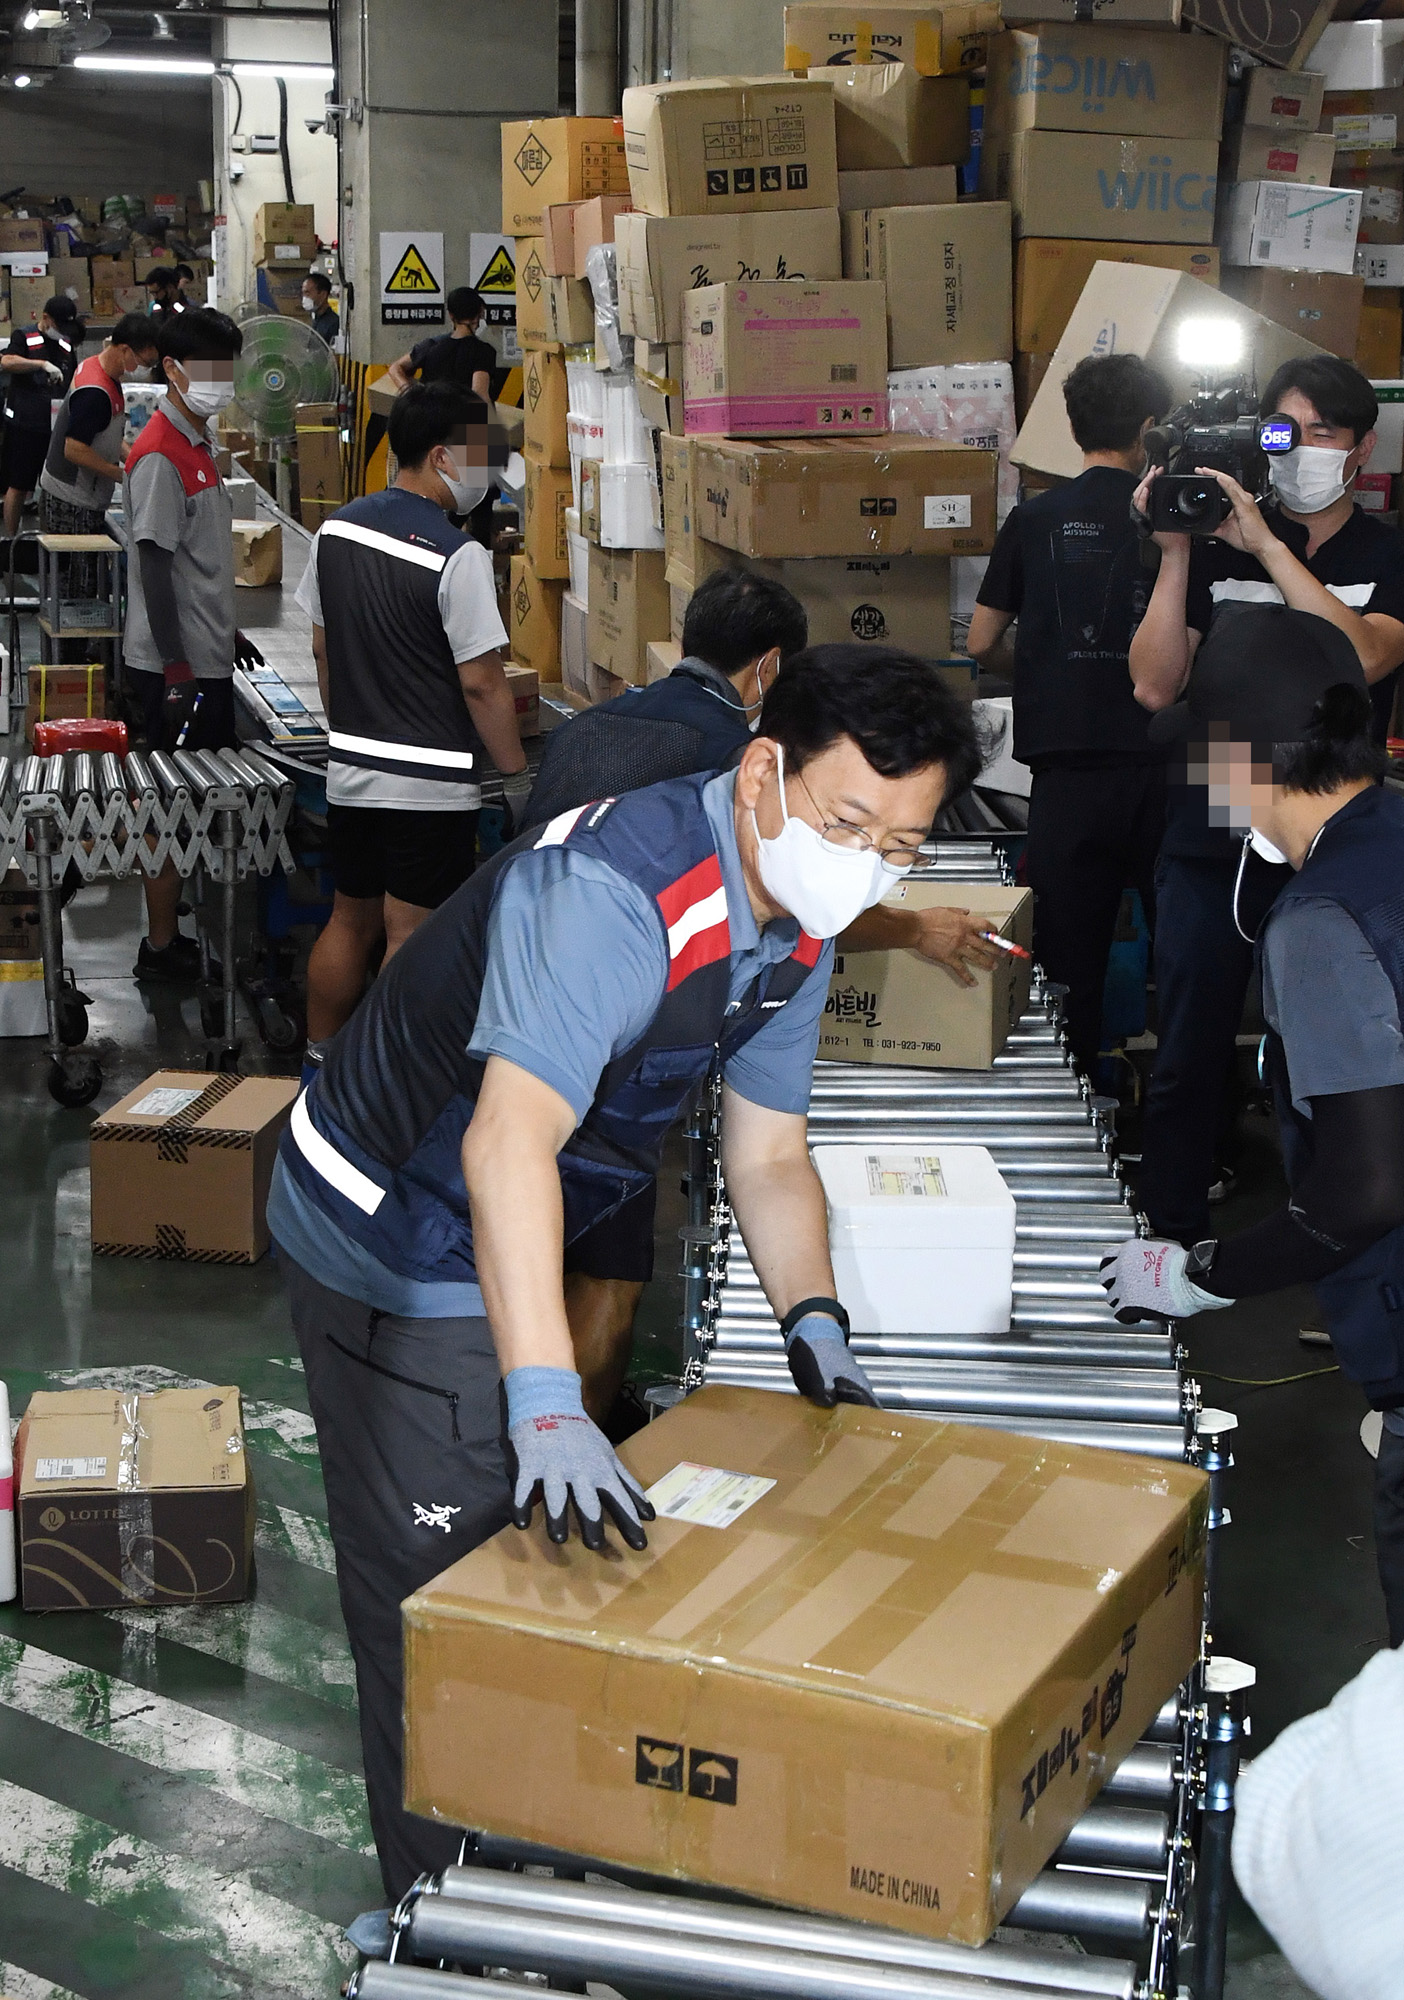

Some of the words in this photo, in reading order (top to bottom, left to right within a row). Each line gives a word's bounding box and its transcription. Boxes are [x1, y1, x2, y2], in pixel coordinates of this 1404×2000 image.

[773, 144, 801, 153] COLOR
[943, 242, 955, 270] 의자
[944, 276, 957, 334] 자세교정
[1261, 431, 1291, 445] OBS
[941, 503, 956, 512] SH
[1062, 521, 1097, 530] APOLLO
[1063, 529, 1099, 537] MISSION
[824, 991, 882, 1028] 아트빌
[825, 1036, 849, 1046] 612-1
[863, 1038, 875, 1048] TEL
[881, 1040, 941, 1052] 031-923-7950
[1154, 1255, 1163, 1287] HITGRIP
[70, 1508, 121, 1521] LOTTE
[1020, 1685, 1099, 1821] 재미누리
[850, 1866, 885, 1896] MADE
[887, 1875, 900, 1900] IN
[902, 1878, 941, 1910] CHINA
